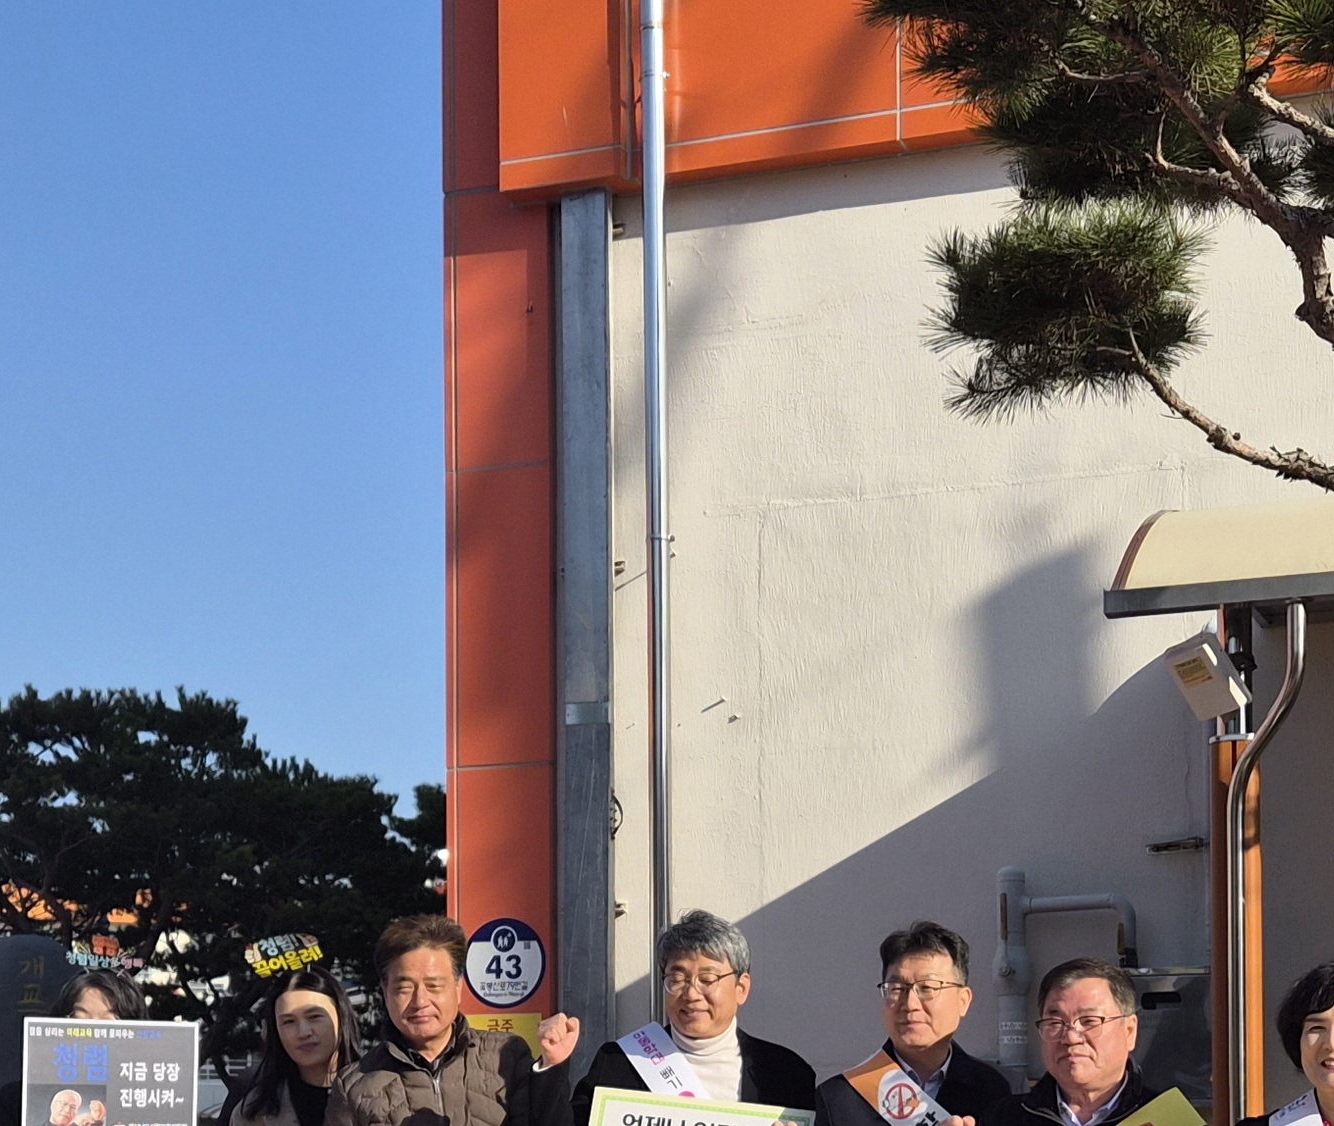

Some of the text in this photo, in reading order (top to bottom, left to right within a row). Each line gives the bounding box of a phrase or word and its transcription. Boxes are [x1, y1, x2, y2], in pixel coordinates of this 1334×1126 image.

[258, 934, 299, 956] 청렴!
[252, 945, 323, 978] 끌어올려!
[485, 954, 522, 979] 43
[52, 1043, 109, 1083] 청렴
[119, 1062, 180, 1082] 지금 당장
[659, 1065, 684, 1090] 빼기
[119, 1089, 184, 1108] 진행시켜~
